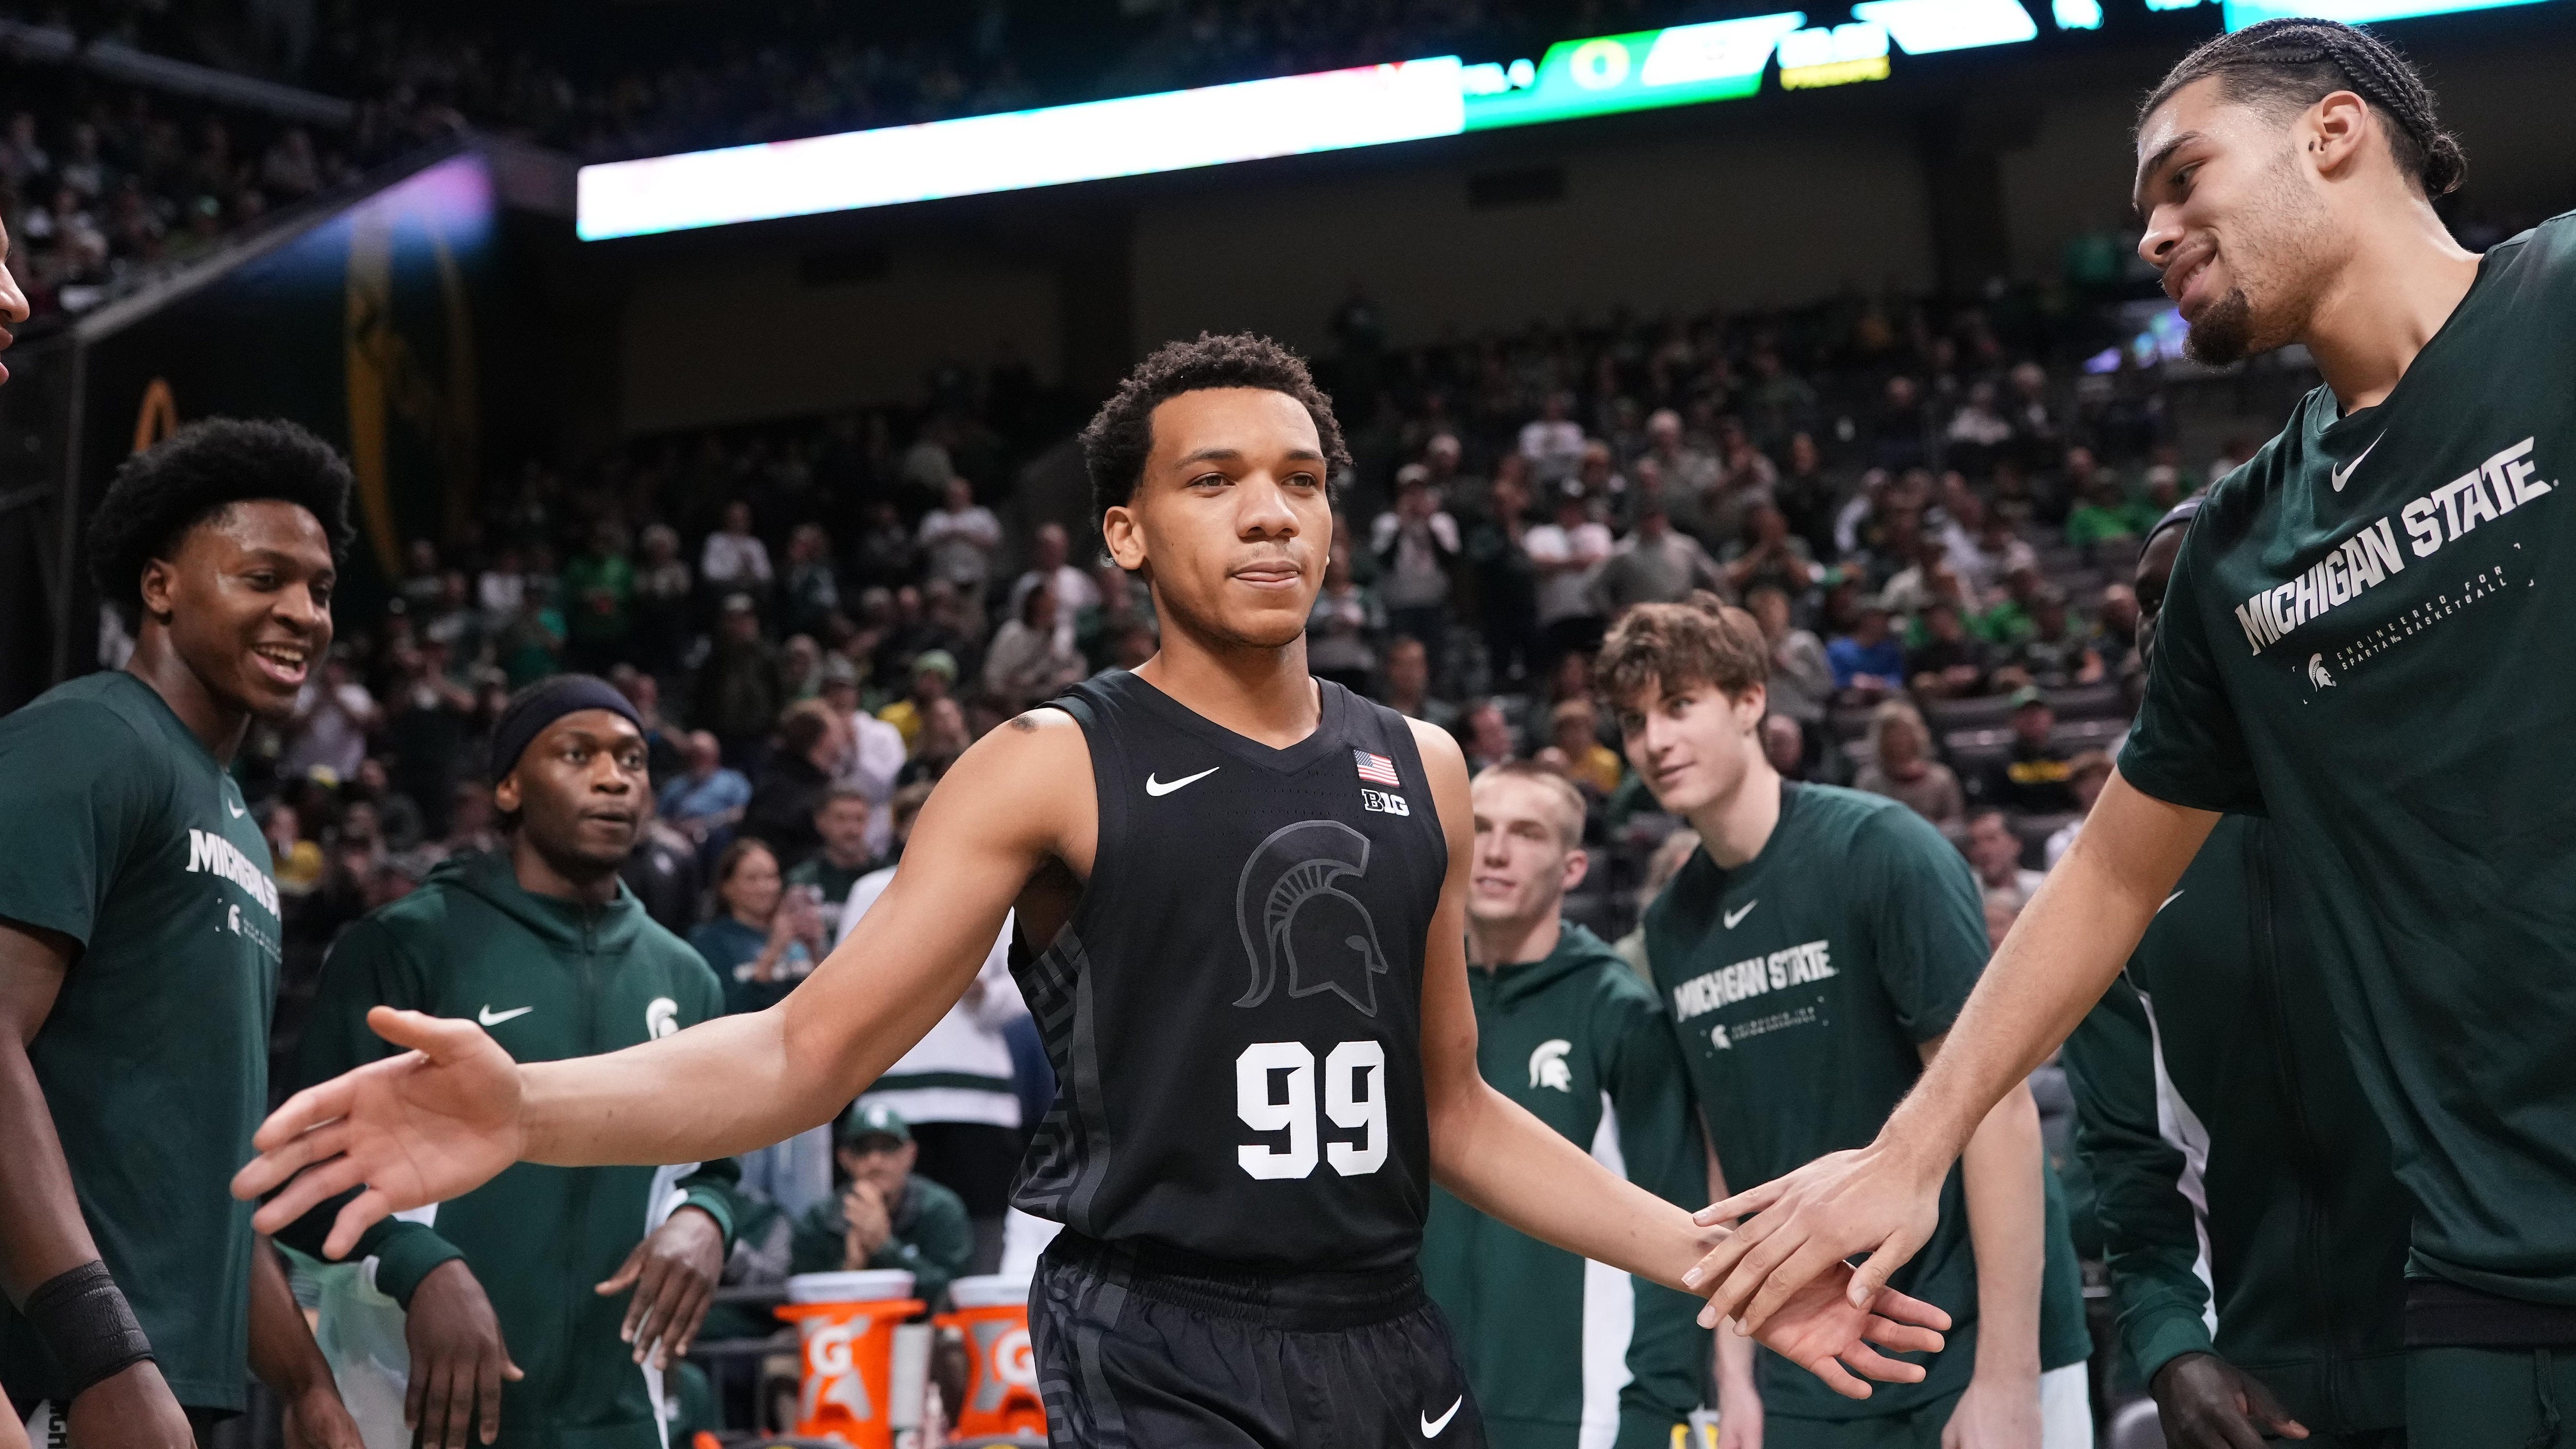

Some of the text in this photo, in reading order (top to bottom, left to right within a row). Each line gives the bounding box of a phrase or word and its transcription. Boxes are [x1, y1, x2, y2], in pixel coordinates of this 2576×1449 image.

[2235, 436, 2552, 656] MICHIGAN STATE
[2336, 566, 2503, 660] ENGINEERED FOR
[2405, 578, 2507, 635] BASKETBALL
[1673, 956, 1769, 1023] MICHIGAN
[1767, 939, 1836, 990] STATE
[1235, 1040, 1388, 1180] 99
[808, 1325, 853, 1376] G
